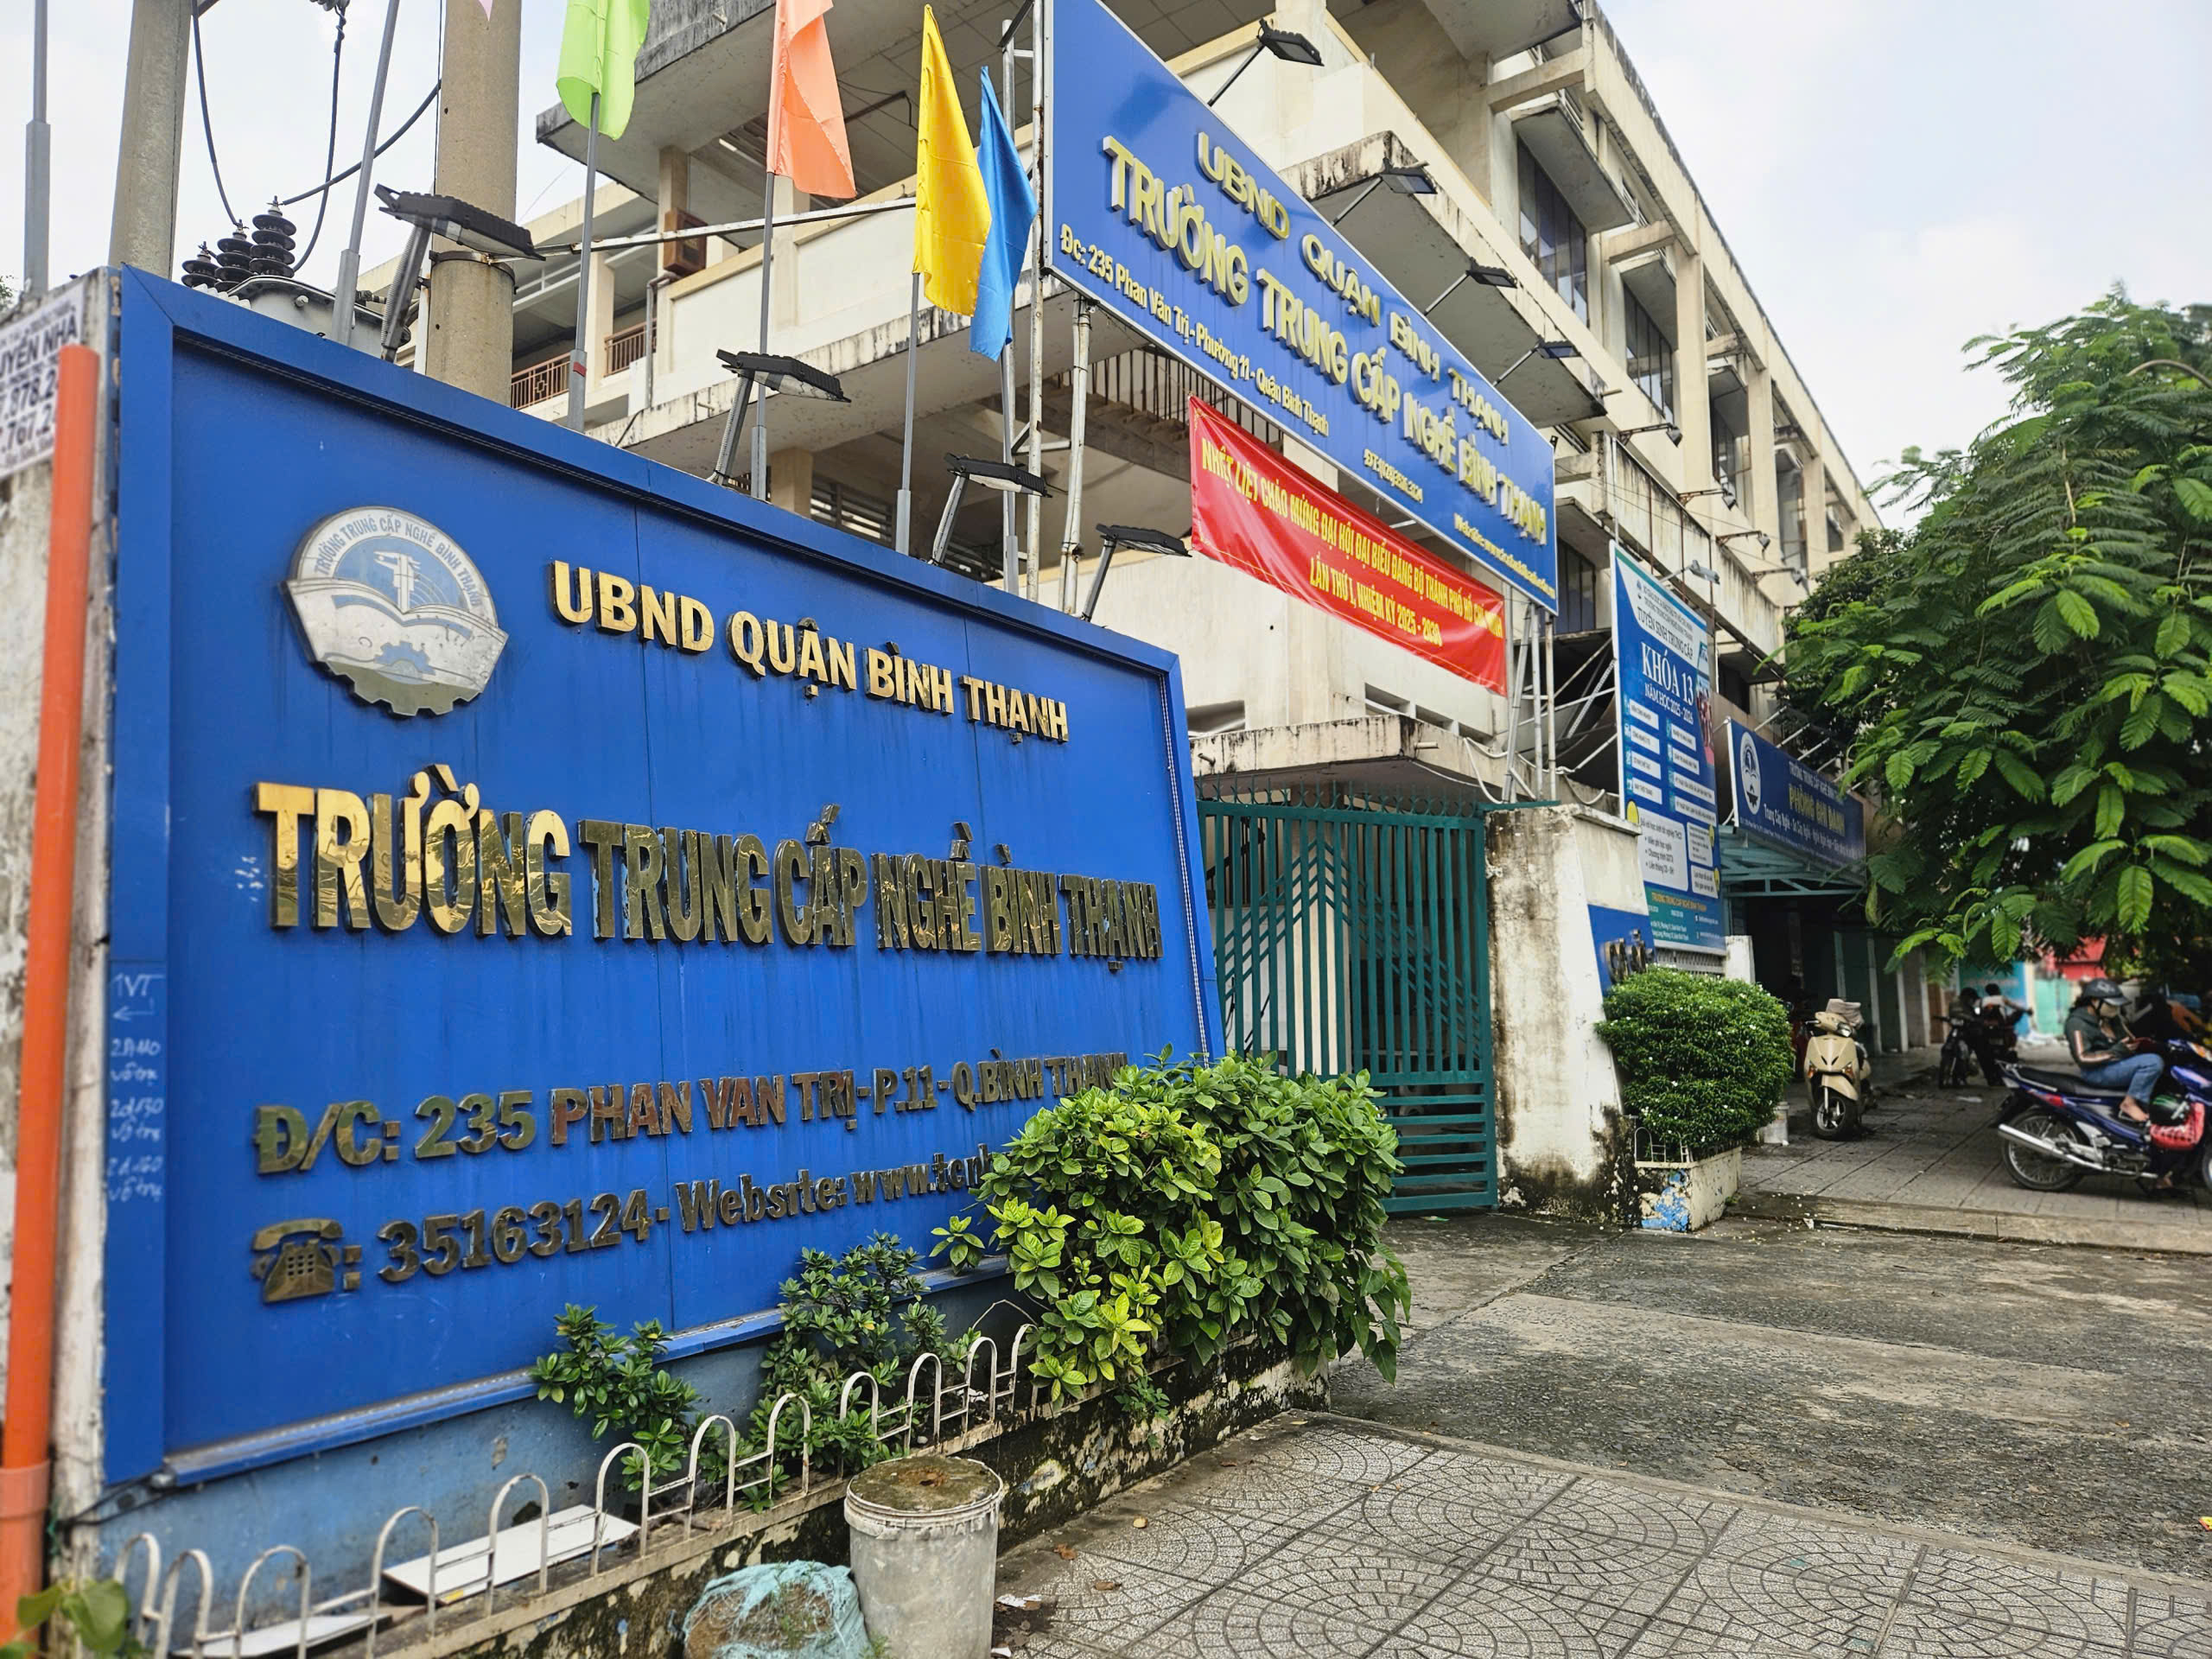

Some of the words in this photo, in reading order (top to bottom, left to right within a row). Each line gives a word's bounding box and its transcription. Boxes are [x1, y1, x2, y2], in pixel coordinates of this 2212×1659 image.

[1088, 245, 1114, 283] 235
[1115, 263, 1147, 309] Phan
[1148, 287, 1172, 326] Văn
[1198, 131, 1290, 240] UBND
[1301, 234, 1380, 327] QUẬN
[1390, 312, 1440, 383] BÌNH
[1447, 368, 1509, 446] THẠNH
[1103, 135, 1249, 306] TRƯỜNG
[1256, 268, 1348, 385] TRUNG
[1351, 346, 1401, 423] CẤP
[1403, 391, 1457, 474] NGHỀ
[1459, 433, 1497, 506] BÌNH
[1497, 473, 1548, 546] THẠNH
[1236, 461, 1258, 505] LIỆT
[1290, 493, 1319, 537] MỪNG
[1321, 512, 1338, 550] ĐẠI
[1310, 550, 1330, 593] LẦN
[1397, 603, 1417, 636] 2025
[551, 560, 715, 653] UBND
[726, 617, 857, 698] QUẬN
[864, 641, 954, 715] BÌNH
[958, 675, 1069, 744] THẠNH
[1641, 641, 1680, 698] KHÓA
[1681, 672, 1694, 706] 13
[252, 764, 572, 937] TRƯỜNG
[578, 819, 774, 944] TRUNG
[774, 804, 868, 947] CẤP
[871, 822, 982, 952] NGHỀ
[980, 843, 1063, 956] BÌNH
[1060, 873, 1163, 972] THẠNH
[253, 1099, 401, 1174] Đ/C:
[415, 1090, 537, 1159] 235
[550, 1080, 693, 1145] PHAN
[699, 1075, 785, 1128] VAN
